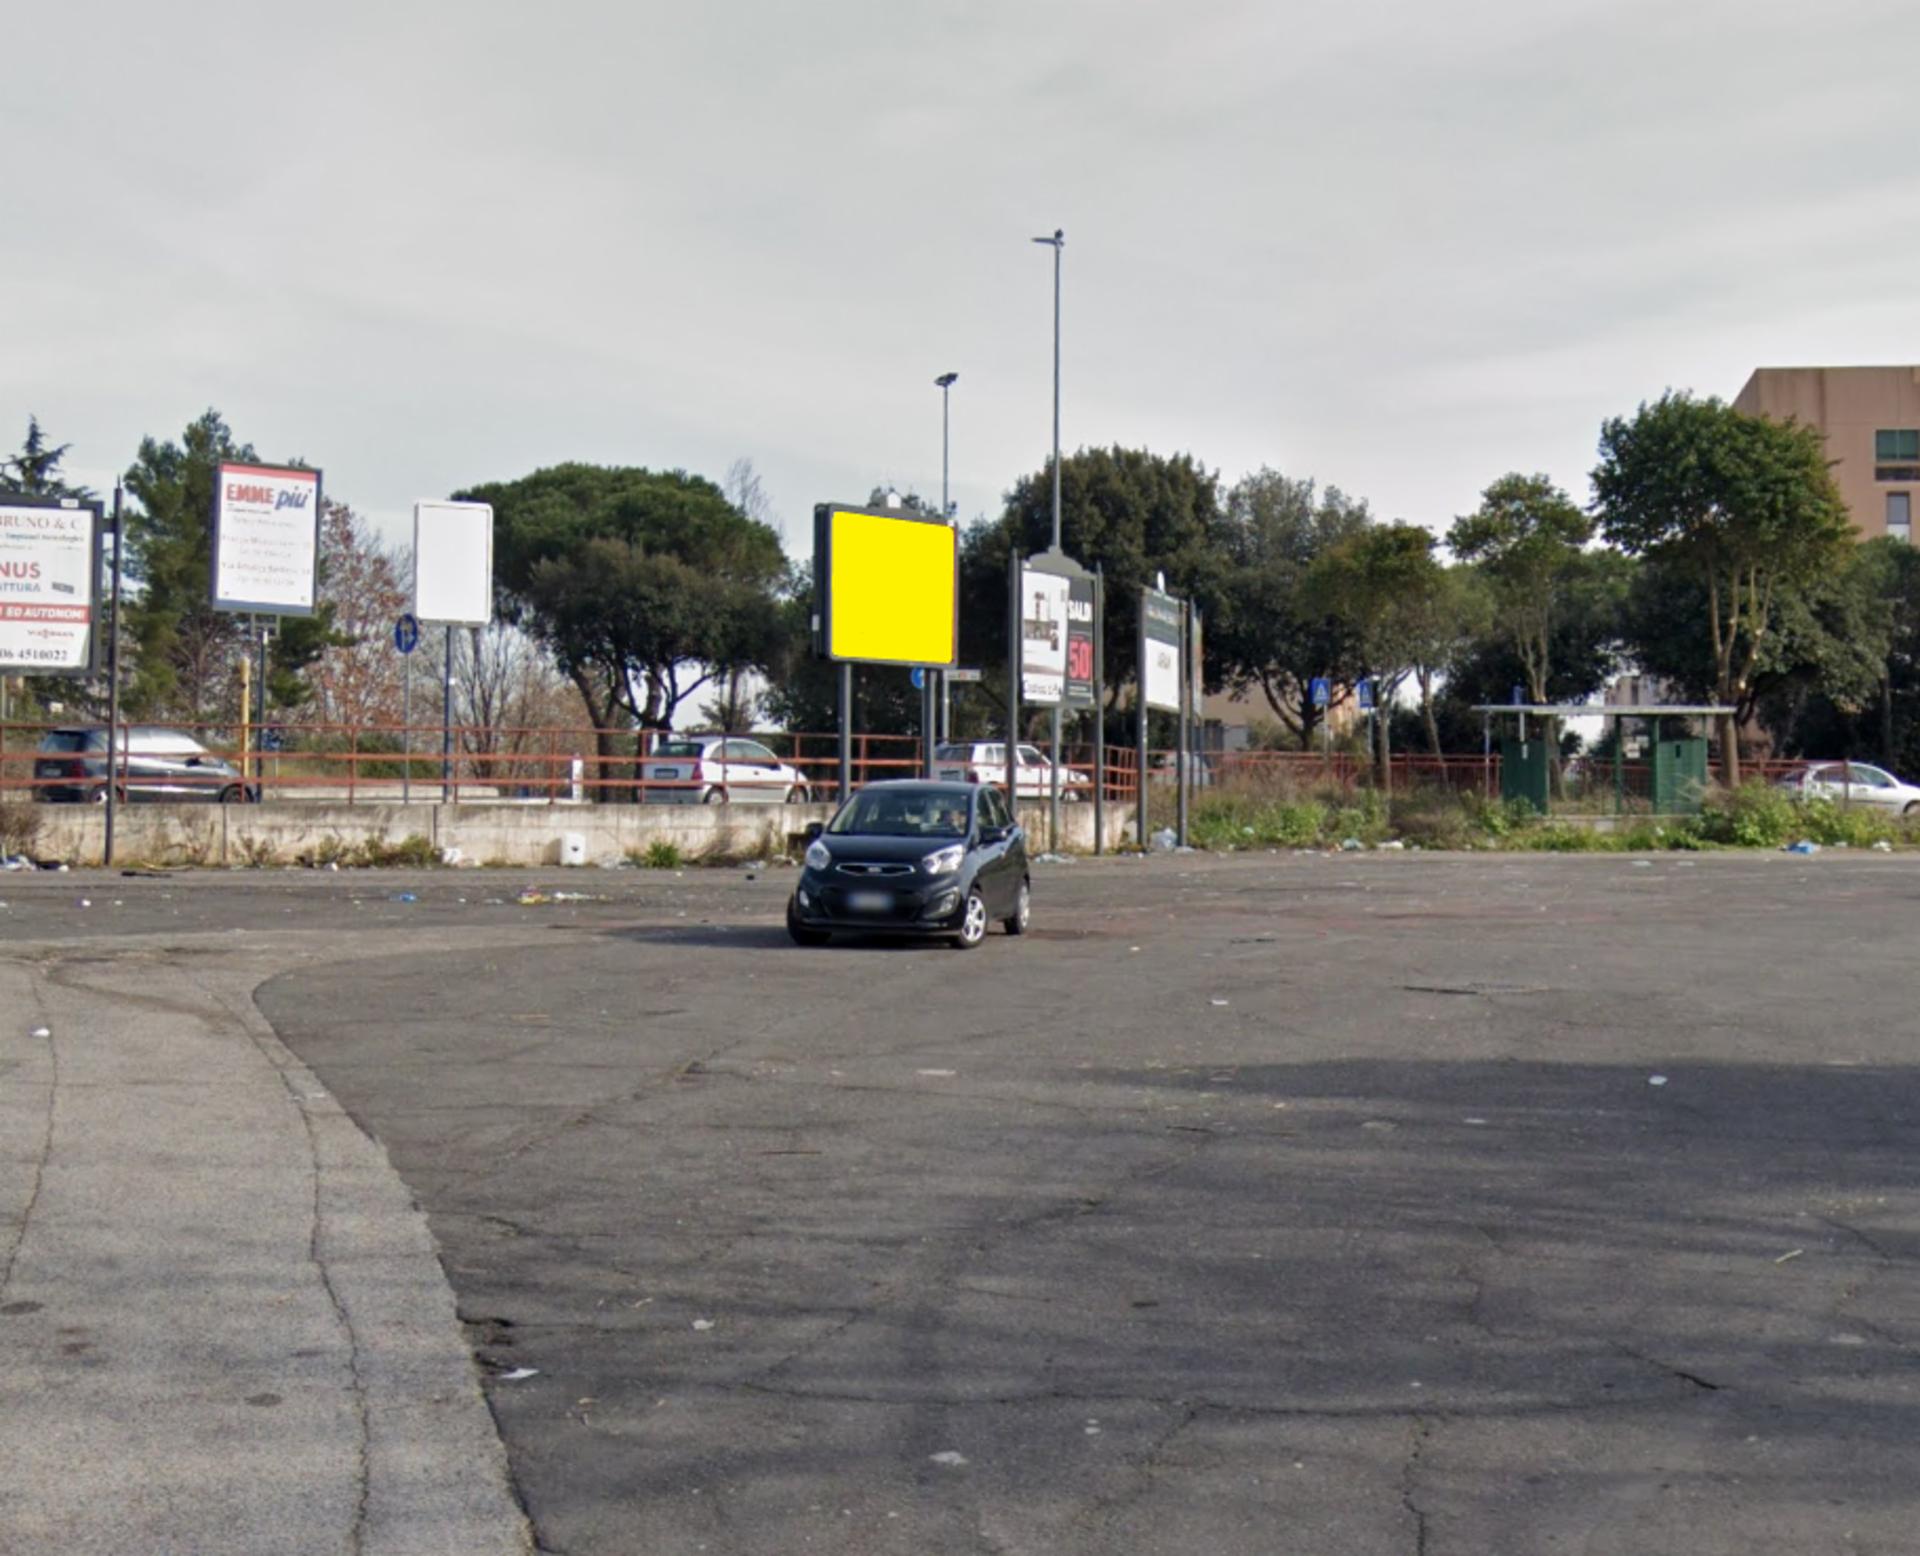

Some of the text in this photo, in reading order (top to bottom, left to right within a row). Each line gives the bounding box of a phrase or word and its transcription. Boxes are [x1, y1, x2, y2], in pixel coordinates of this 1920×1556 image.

[226, 483, 274, 504] EMME
[274, 485, 313, 511] più
[54, 517, 65, 529] &
[23, 607, 84, 620] AUTONOMI
